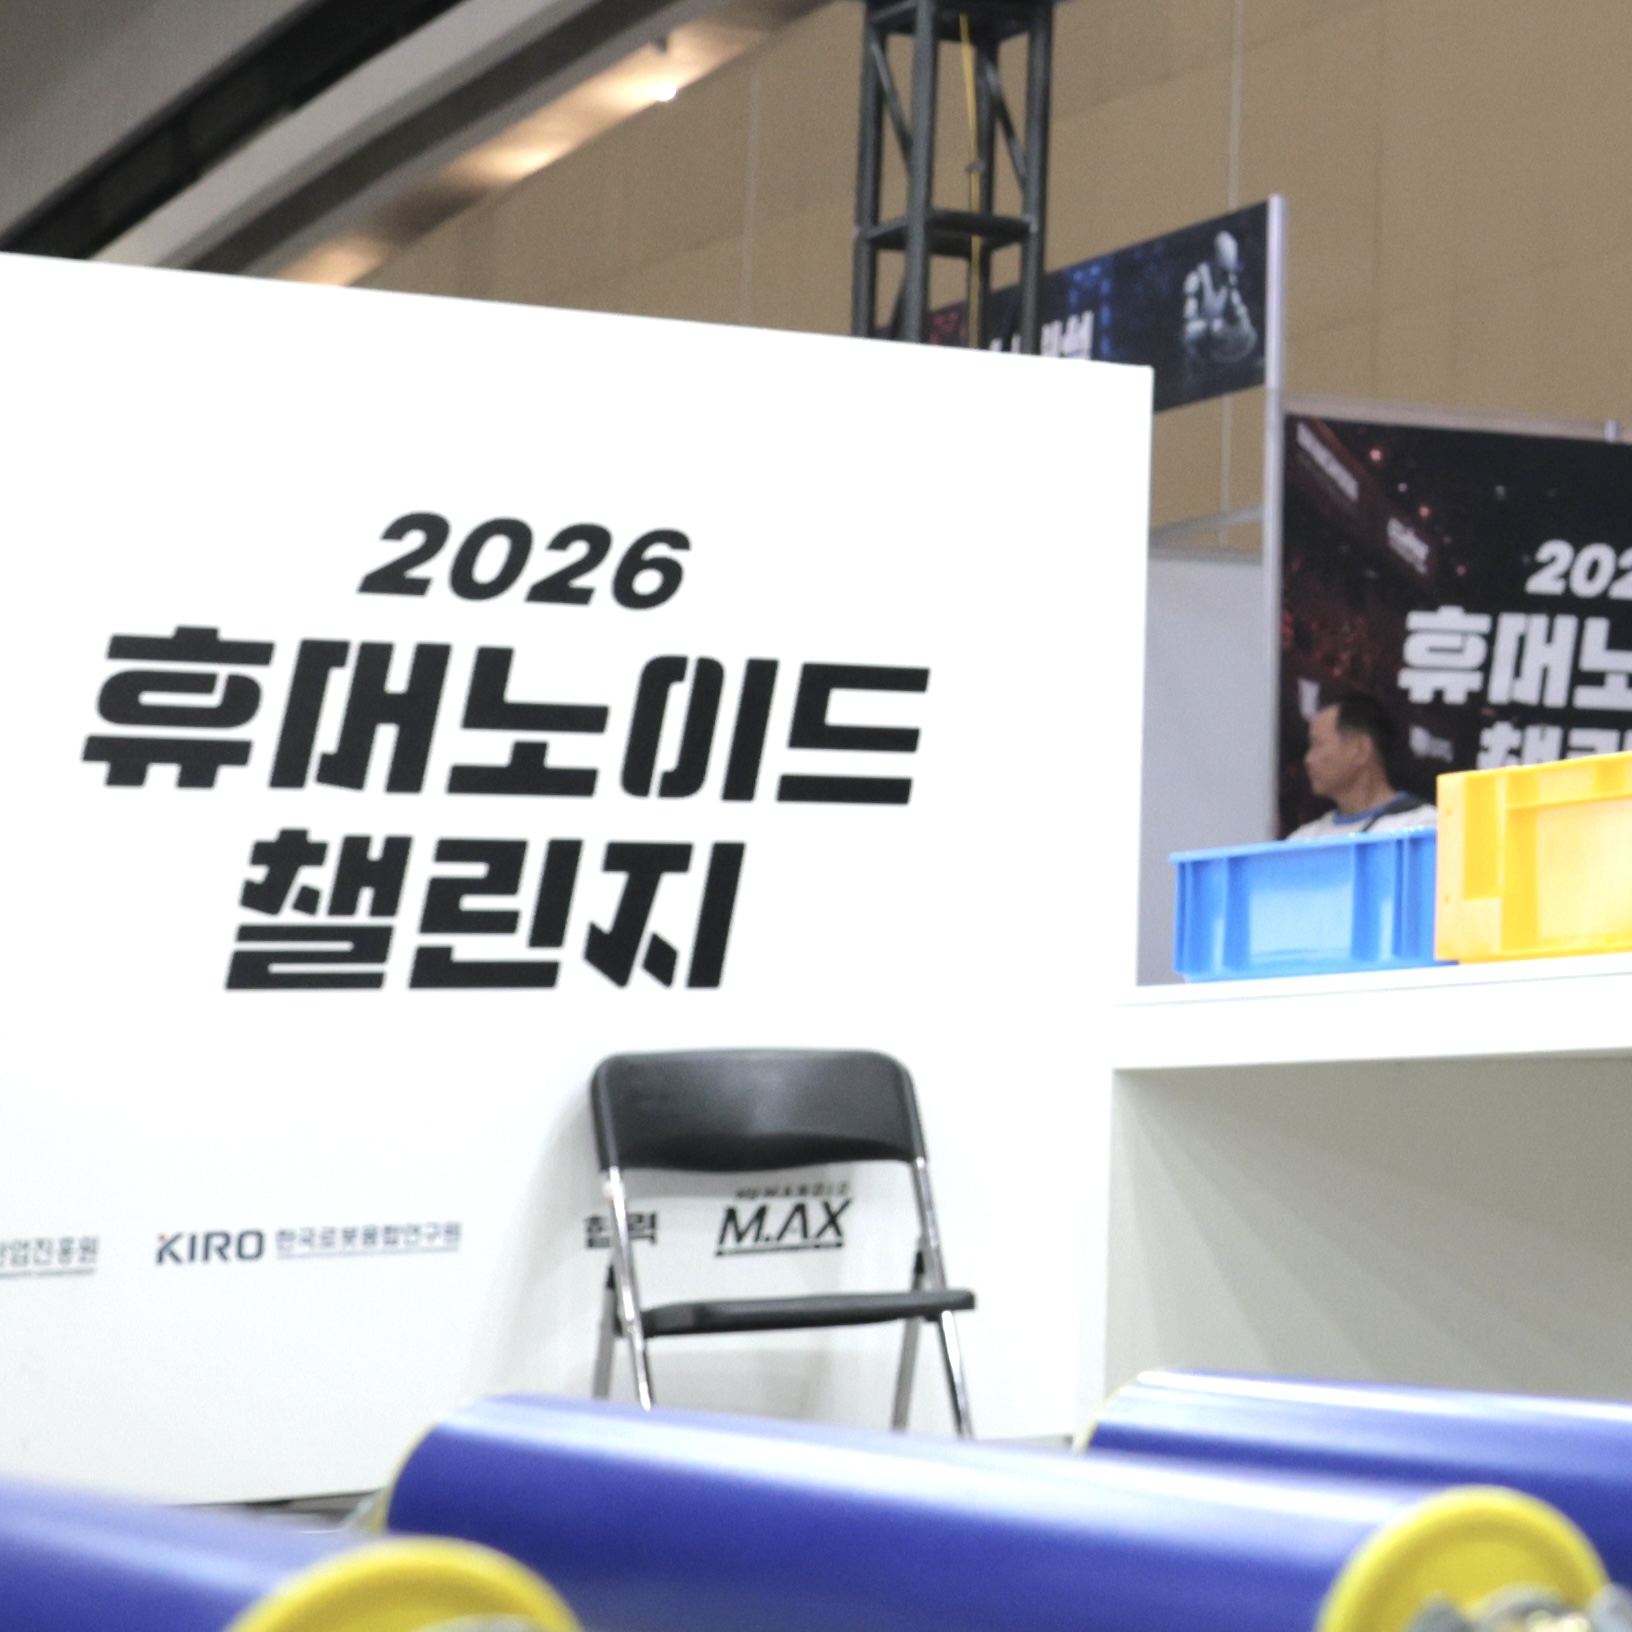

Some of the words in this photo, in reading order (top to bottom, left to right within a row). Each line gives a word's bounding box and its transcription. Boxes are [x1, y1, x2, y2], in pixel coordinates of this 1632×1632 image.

[357, 510, 691, 610] 2026
[82, 625, 931, 806] 휴머노이드
[225, 827, 746, 990] 챌린지
[156, 1230, 264, 1265] KIRO
